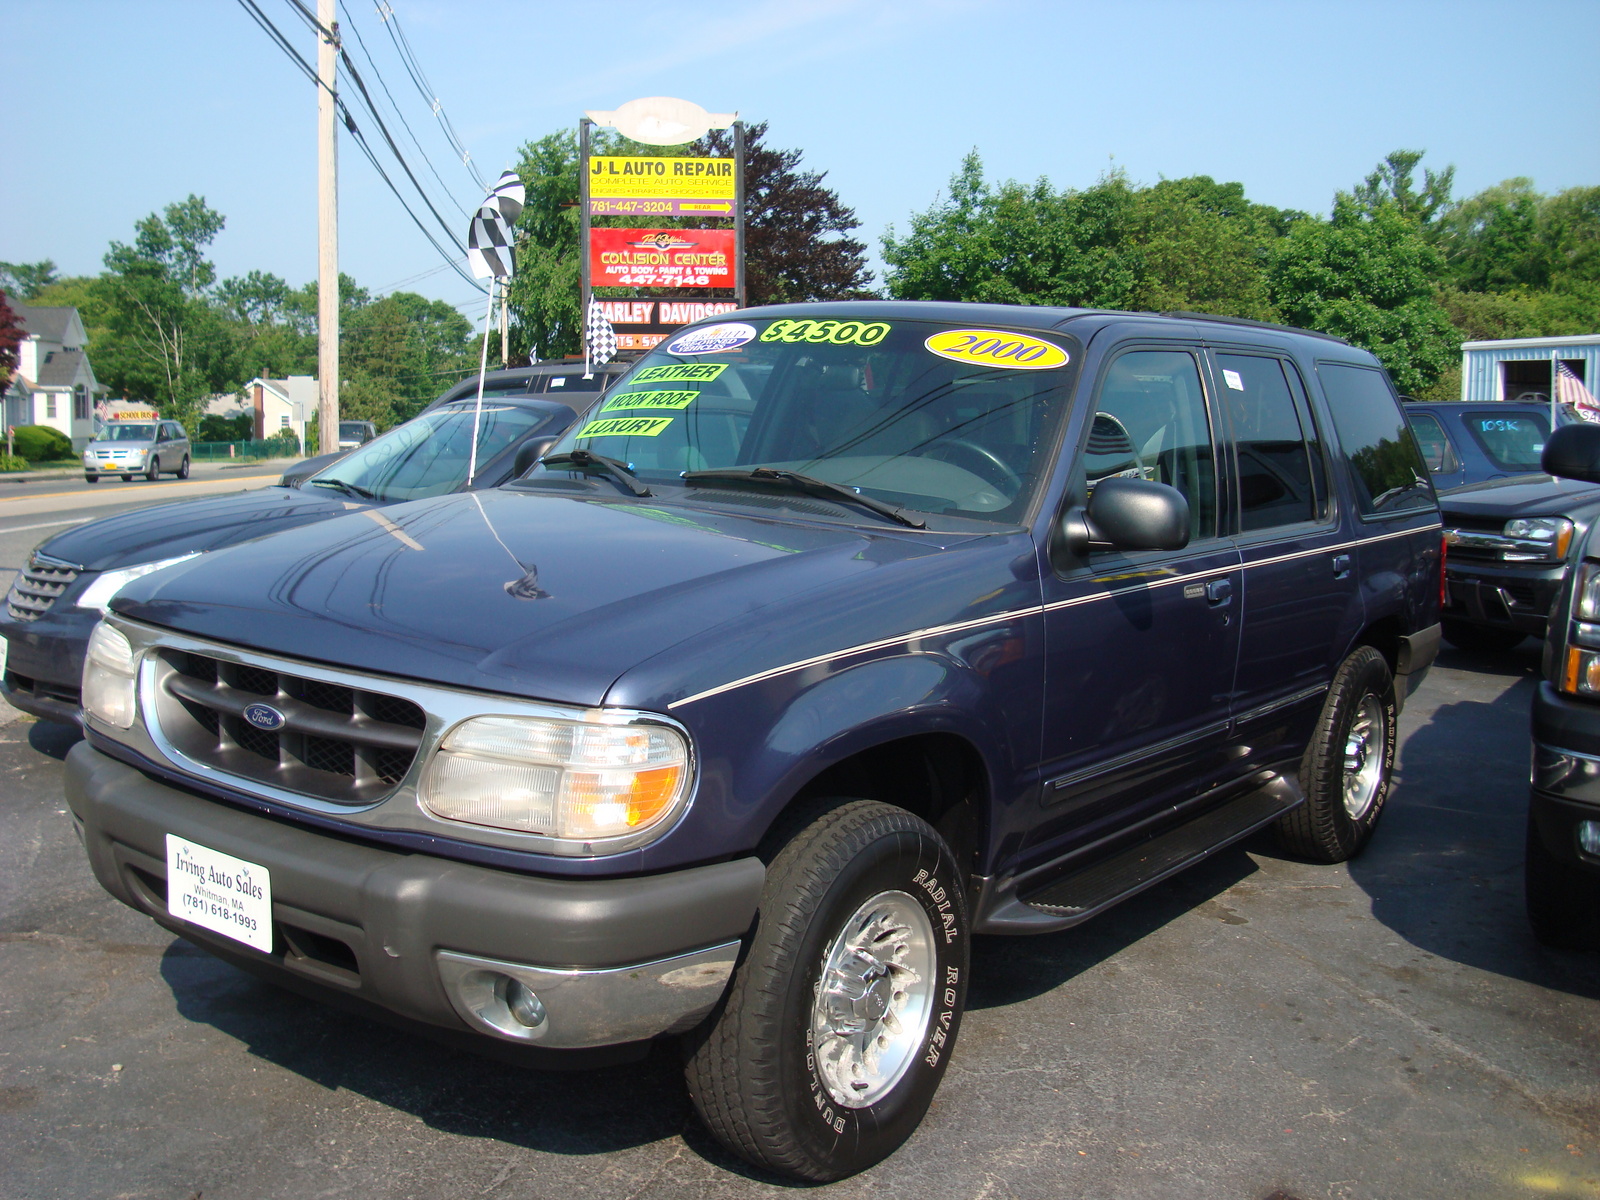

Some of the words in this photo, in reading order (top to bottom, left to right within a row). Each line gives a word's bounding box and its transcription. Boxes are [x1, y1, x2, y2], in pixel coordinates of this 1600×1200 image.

[623, 162, 665, 175] AUTO
[674, 162, 731, 176] REPAIR
[591, 177, 650, 185] COMPLETE
[654, 178, 682, 186] AUTO
[591, 201, 672, 212] 781-447-3204
[601, 252, 669, 265] COLLISION
[674, 253, 726, 265] CENTER
[606, 266, 628, 274] AUTO
[619, 275, 709, 286] 447-7146
[598, 302, 655, 324] ARLEY
[766, 322, 886, 343] $4500
[679, 344, 726, 352] VEHICLES
[942, 336, 1047, 362] 2000
[634, 365, 717, 381] LEATHER
[609, 393, 646, 408] MOON
[648, 392, 692, 407] ROOF
[584, 420, 661, 436] LUXURY
[1481, 420, 1519, 432] 108K
[252, 709, 273, 725] Ford
[1386, 704, 1395, 769] RADIAL
[176, 853, 205, 884] Irving
[208, 865, 232, 888] Auto
[236, 874, 263, 900] Sales
[194, 884, 229, 907] Whitman,
[232, 898, 244, 911] MA
[183, 893, 208, 914] (781)
[211, 904, 257, 931] 618-1993
[913, 869, 958, 944] RADIAL
[925, 966, 959, 1068] ROVER
[805, 1029, 846, 1134] DUNLOP
